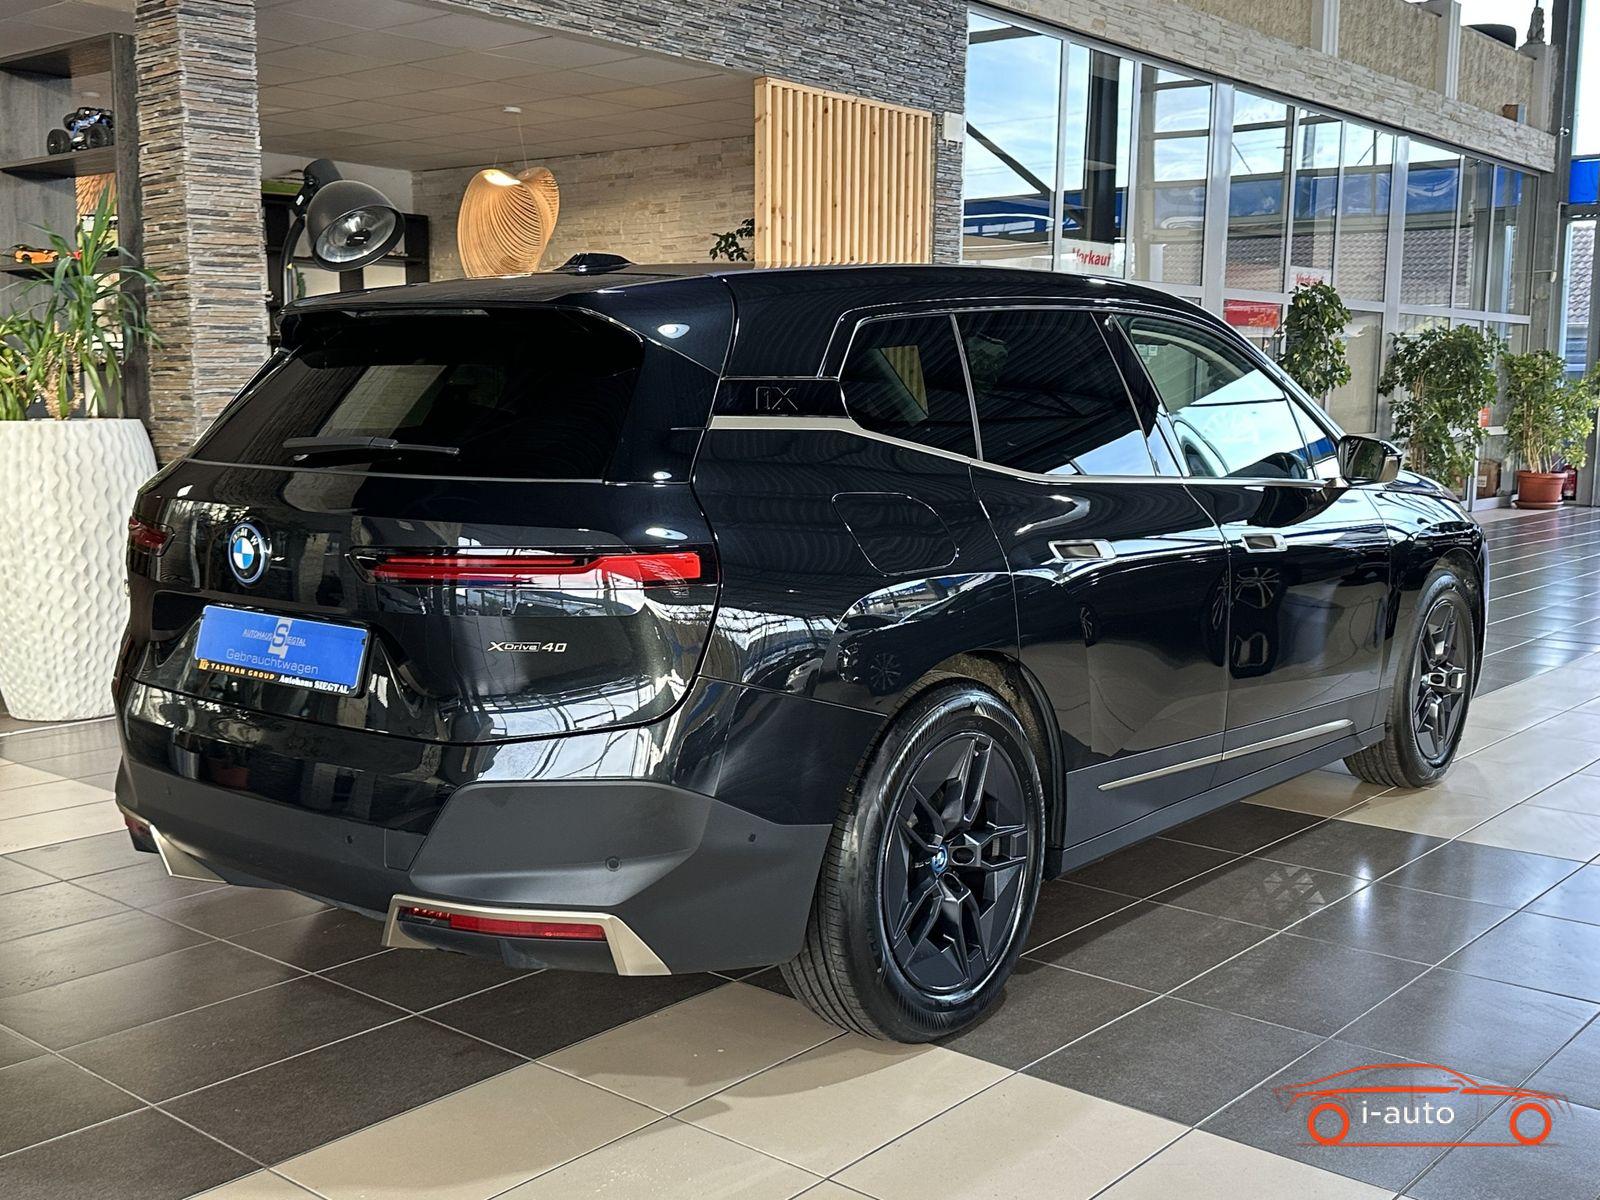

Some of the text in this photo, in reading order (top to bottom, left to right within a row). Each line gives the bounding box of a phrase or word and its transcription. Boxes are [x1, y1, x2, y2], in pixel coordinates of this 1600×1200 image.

[541, 642, 567, 653] 40
[226, 648, 319, 675] Gebrauchtwagen
[247, 669, 275, 681] GROUP
[313, 680, 350, 694] SIEGTAL
